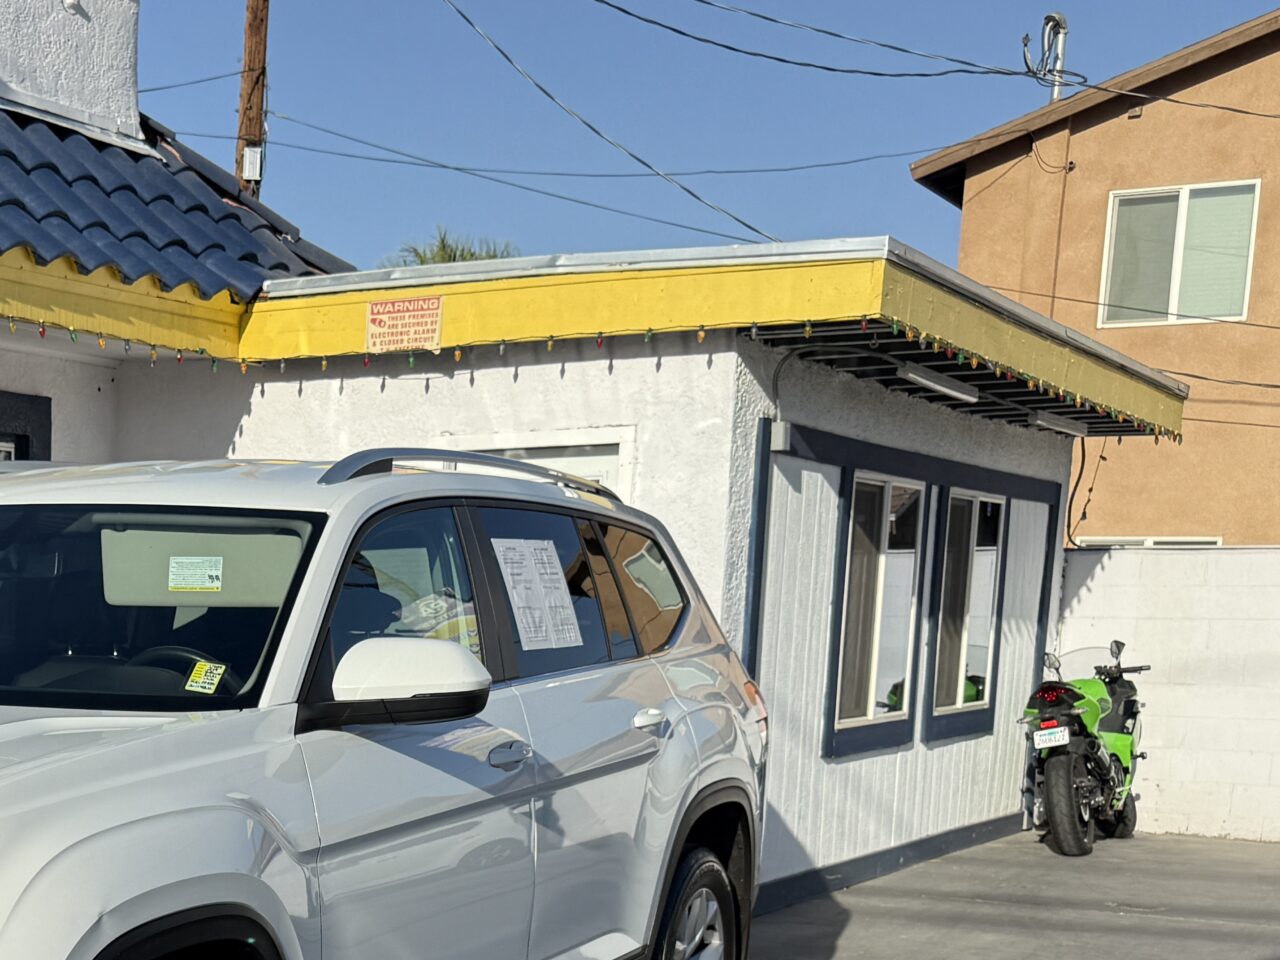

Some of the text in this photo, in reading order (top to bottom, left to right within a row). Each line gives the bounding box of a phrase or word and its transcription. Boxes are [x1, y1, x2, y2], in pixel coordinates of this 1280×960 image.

[372, 299, 439, 314] WARNING
[387, 322, 399, 330] ARE
[400, 320, 429, 329] SECURED
[370, 328, 437, 339] ELECTRONIC ALARM
[379, 338, 404, 347] CLOSED
[407, 336, 434, 344] CIRCUIT
